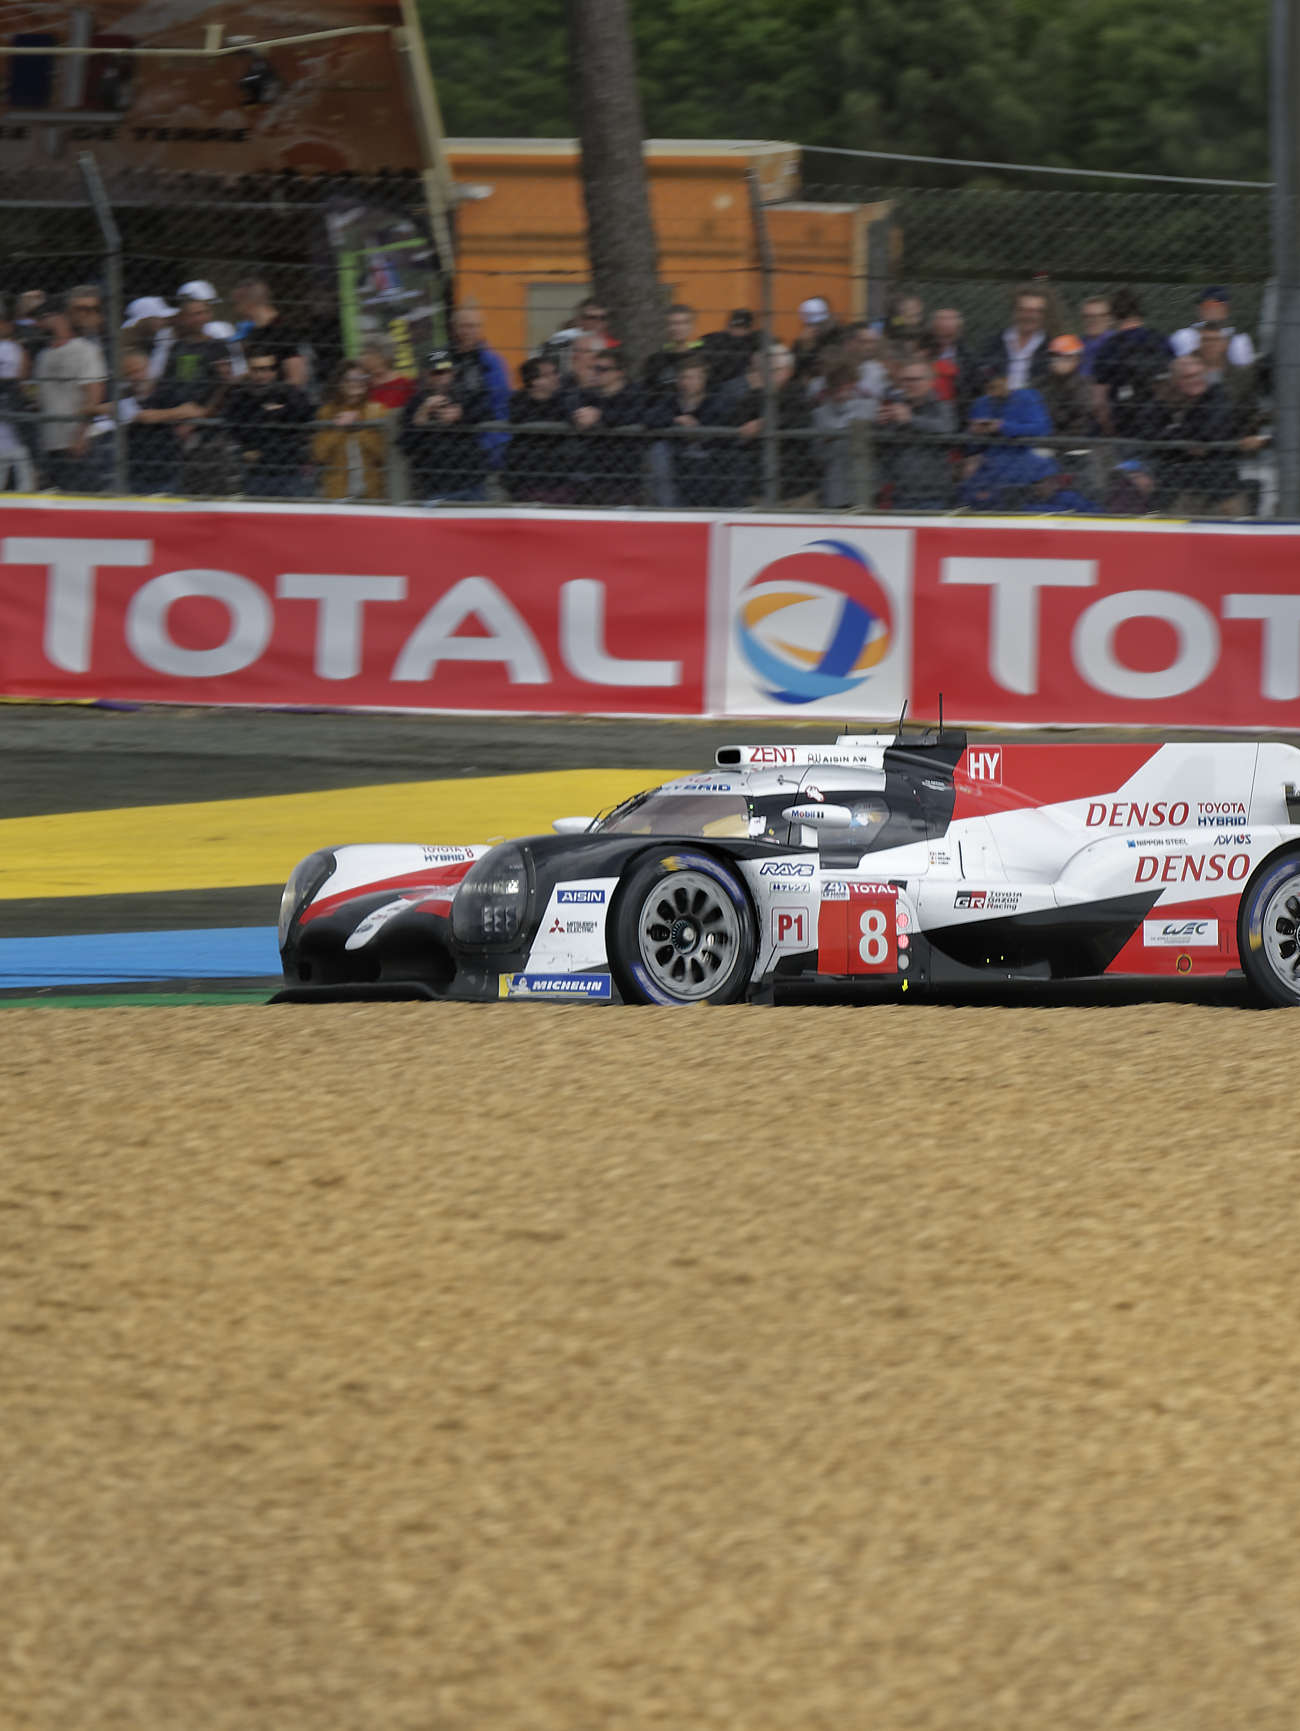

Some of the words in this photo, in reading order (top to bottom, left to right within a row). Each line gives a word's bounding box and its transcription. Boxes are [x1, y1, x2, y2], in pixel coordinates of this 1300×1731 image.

[2, 537, 683, 688] TOTAL
[747, 746, 797, 763] ZENT
[969, 752, 1000, 780] HY
[791, 810, 815, 818] Mobil
[1085, 801, 1190, 827] DENSO
[1197, 802, 1246, 814] TOYOTA
[1197, 816, 1247, 827] HYBRID
[759, 862, 815, 877] RAYS
[1134, 854, 1251, 883] DENSO
[561, 891, 602, 902] AISIN
[853, 884, 897, 894] TOTAL
[955, 896, 985, 908] GR
[778, 914, 803, 942] P1
[858, 909, 888, 965] 8
[531, 980, 603, 992] MICHELIN
